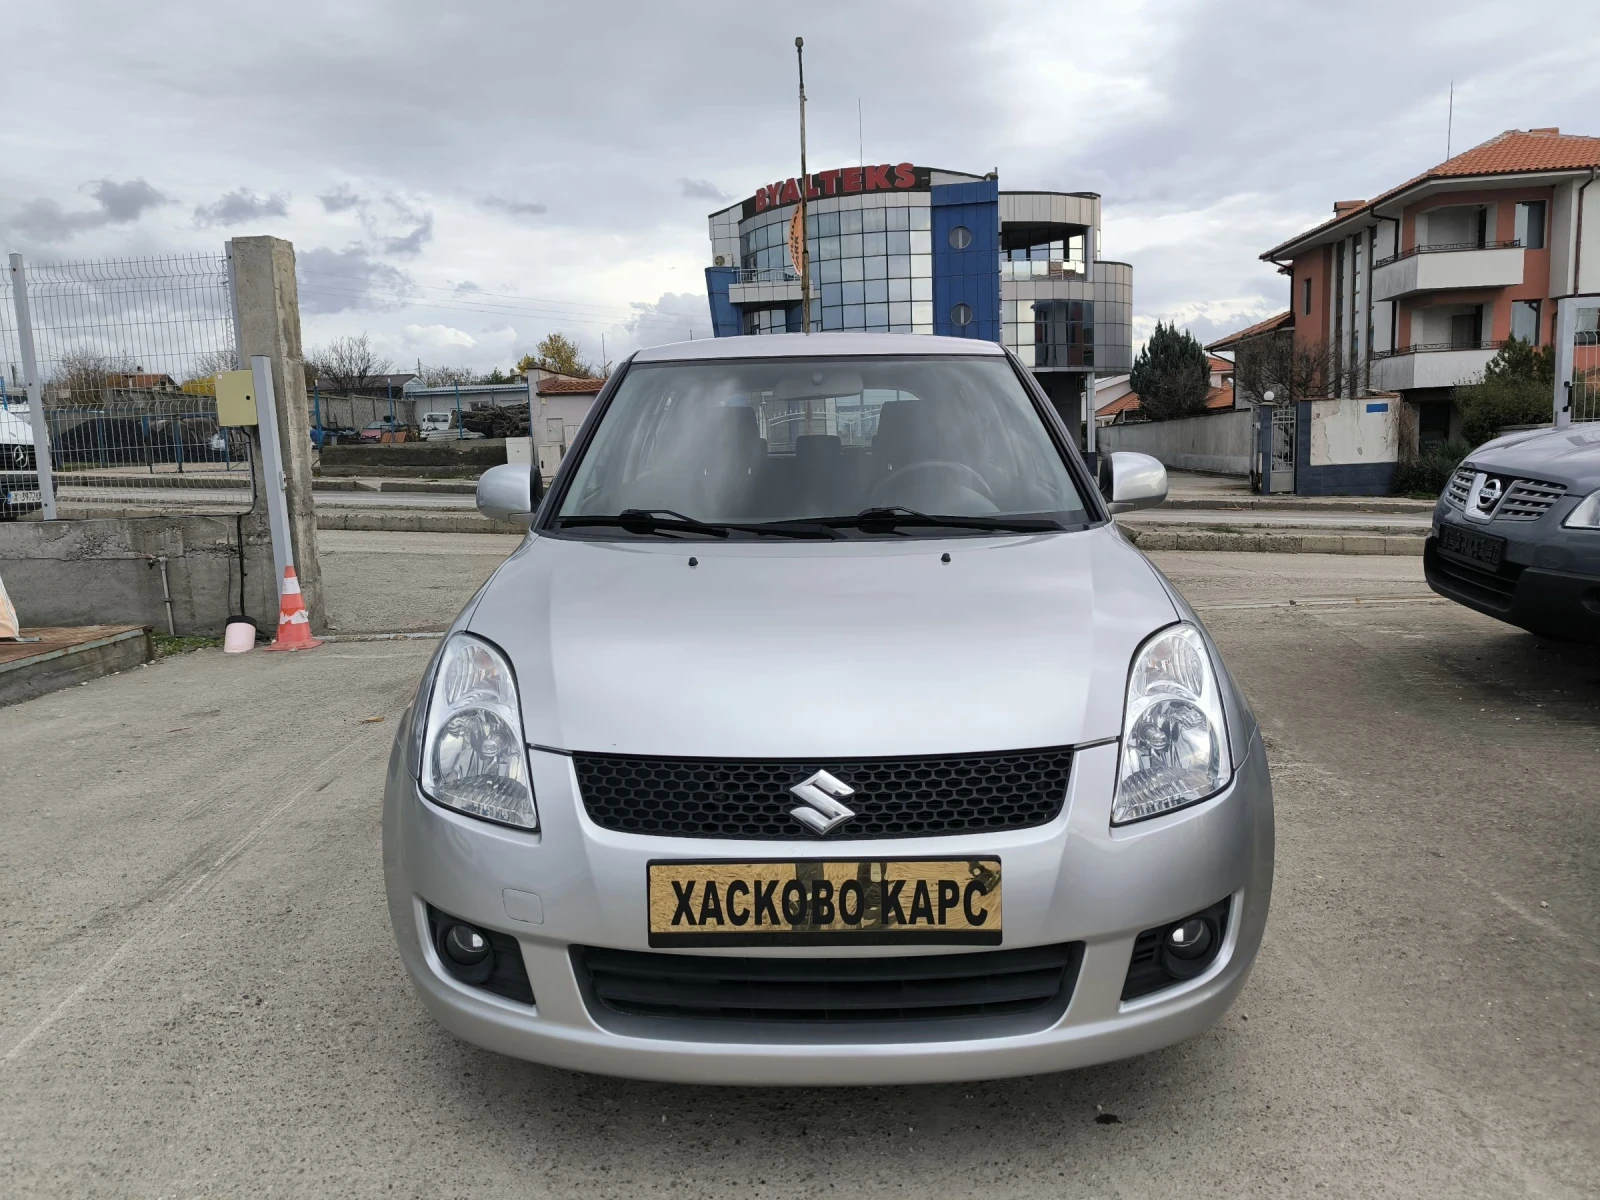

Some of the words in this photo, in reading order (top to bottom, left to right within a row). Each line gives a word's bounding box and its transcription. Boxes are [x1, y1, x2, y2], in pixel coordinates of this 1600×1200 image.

[756, 163, 916, 212] BYALTEKS
[671, 879, 865, 926] ХАСКОВО
[881, 879, 988, 926] КАРС
